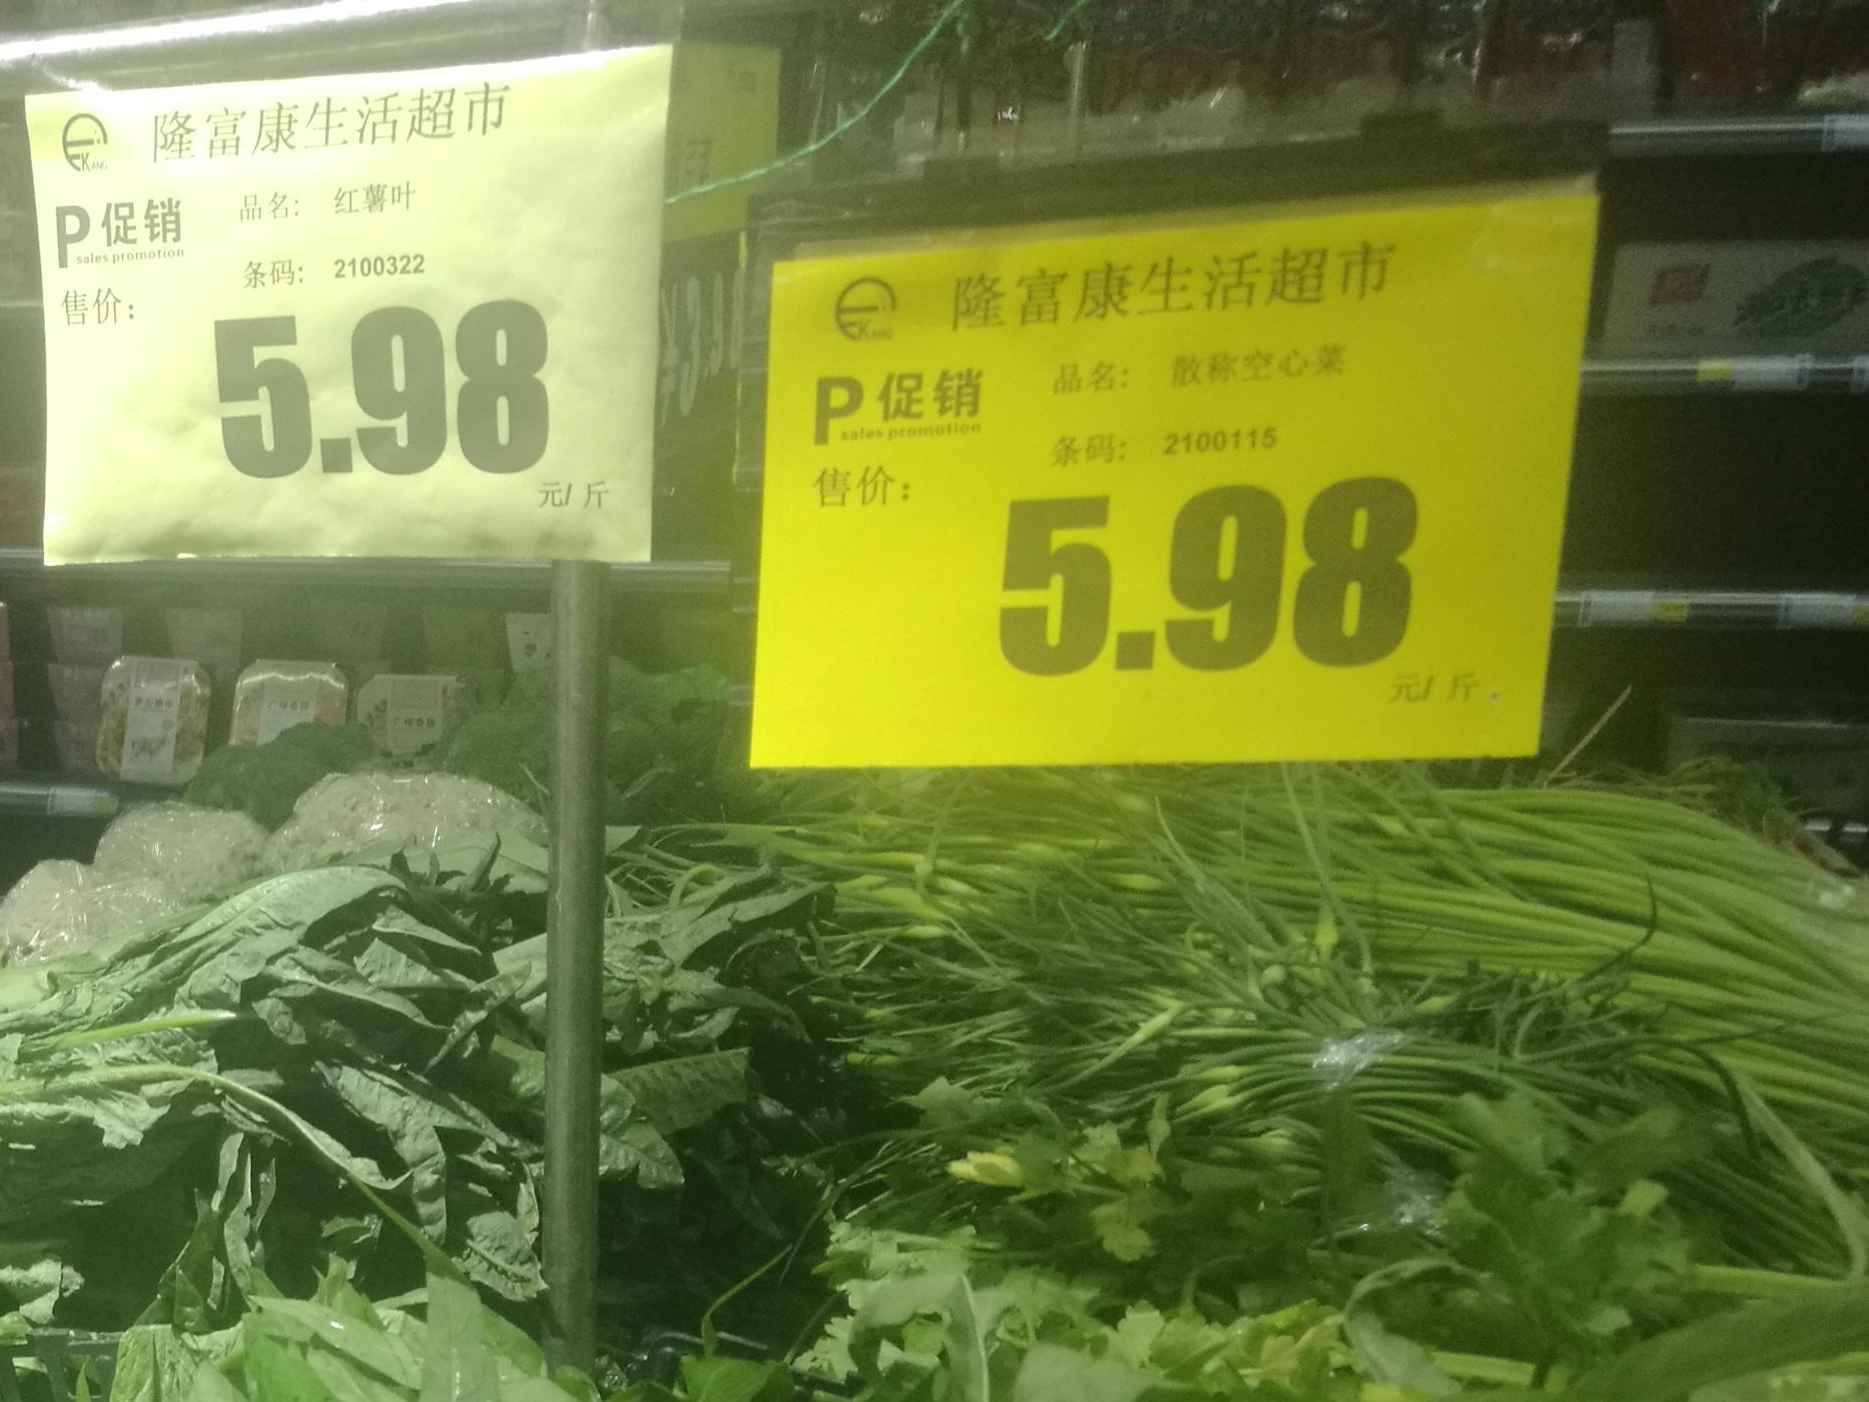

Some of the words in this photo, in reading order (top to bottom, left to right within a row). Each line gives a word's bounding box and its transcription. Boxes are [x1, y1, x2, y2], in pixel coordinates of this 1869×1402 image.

[151, 82, 511, 164] 隆富康生活超市
[333, 182, 417, 217] 红薯叶
[76, 252, 108, 265] sales
[112, 247, 185, 264] promotion
[334, 253, 425, 280] 2100322
[951, 241, 1397, 331] 隆富康生活超市
[1171, 343, 1346, 387] 散称空心菜
[214, 299, 549, 479] 5.98
[840, 426, 883, 442] sales
[887, 421, 982, 441] promotion
[1163, 427, 1278, 457] 2100115
[998, 476, 1419, 677] 5.98
